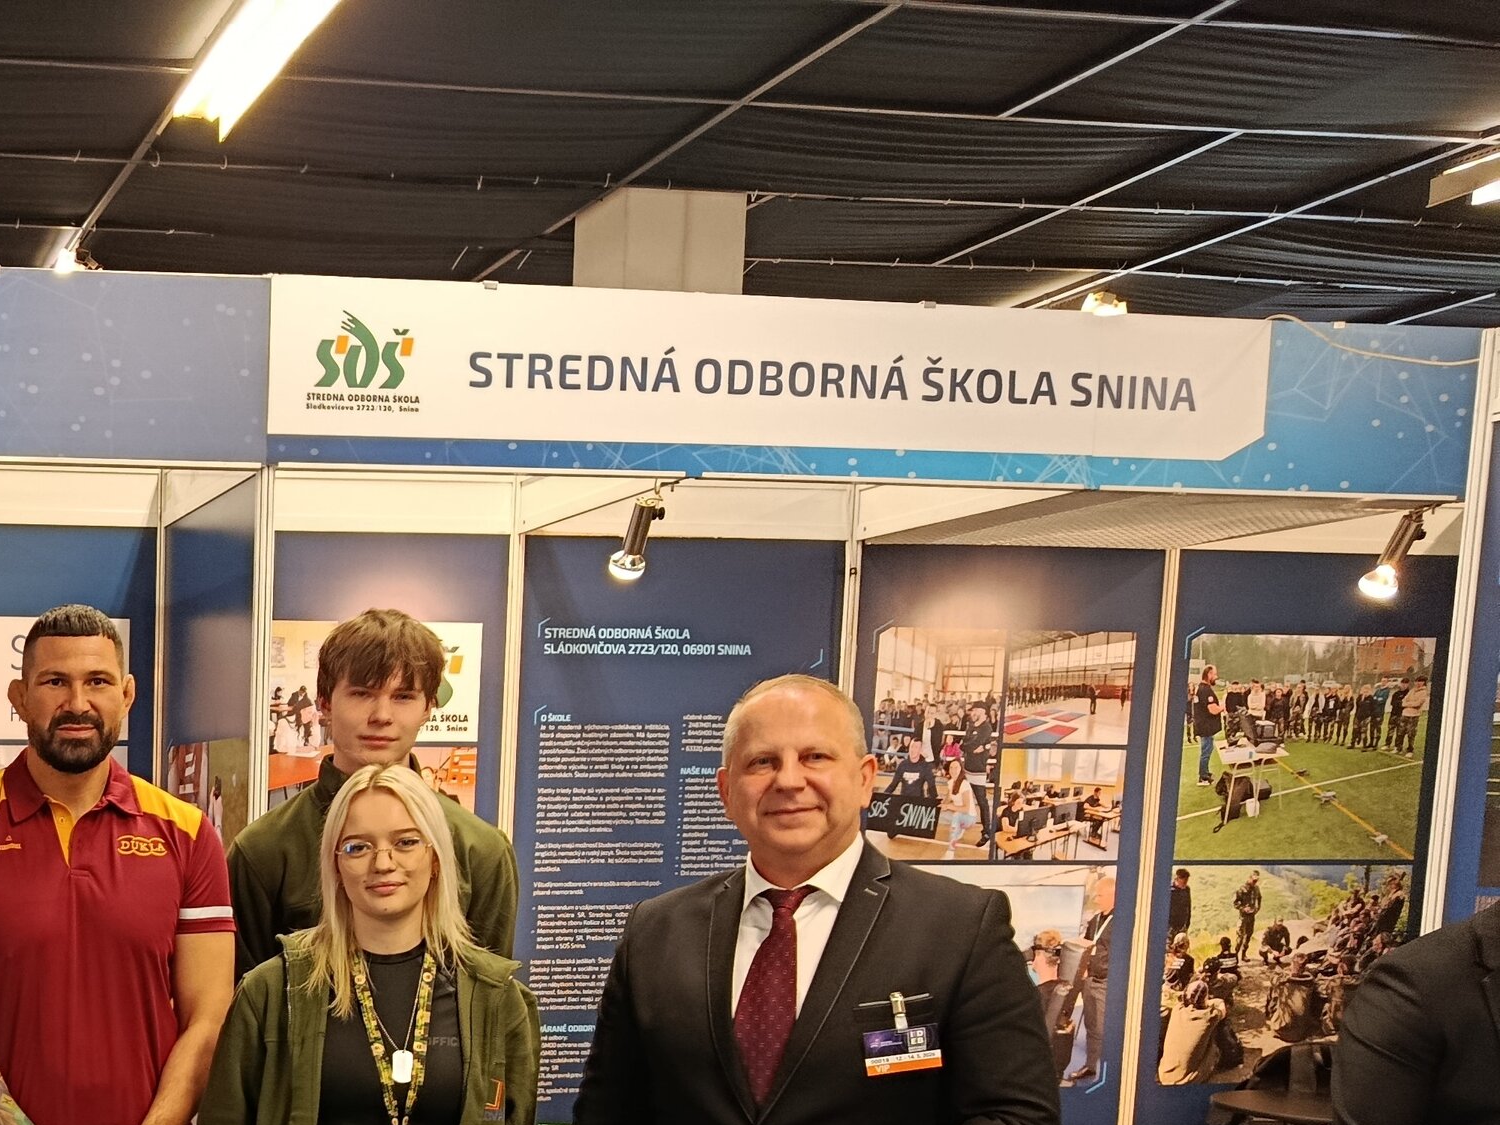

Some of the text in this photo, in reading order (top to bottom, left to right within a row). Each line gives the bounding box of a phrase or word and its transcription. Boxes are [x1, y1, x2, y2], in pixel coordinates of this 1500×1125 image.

[469, 346, 1197, 412] STREDNÁ ODBORNÁ ŠKOLA SNINA
[544, 625, 690, 640] STREDNÁ ODBORNÁ ŠKOLA
[543, 641, 752, 657] SLÁDKOVIČOVA 2723/120, 06901 SNINA
[548, 712, 571, 721] ŠKOLE
[680, 766, 700, 775] NAŠE
[896, 803, 937, 831] SNINA
[121, 840, 165, 852] DUKLA
[875, 1065, 890, 1073] VIP
